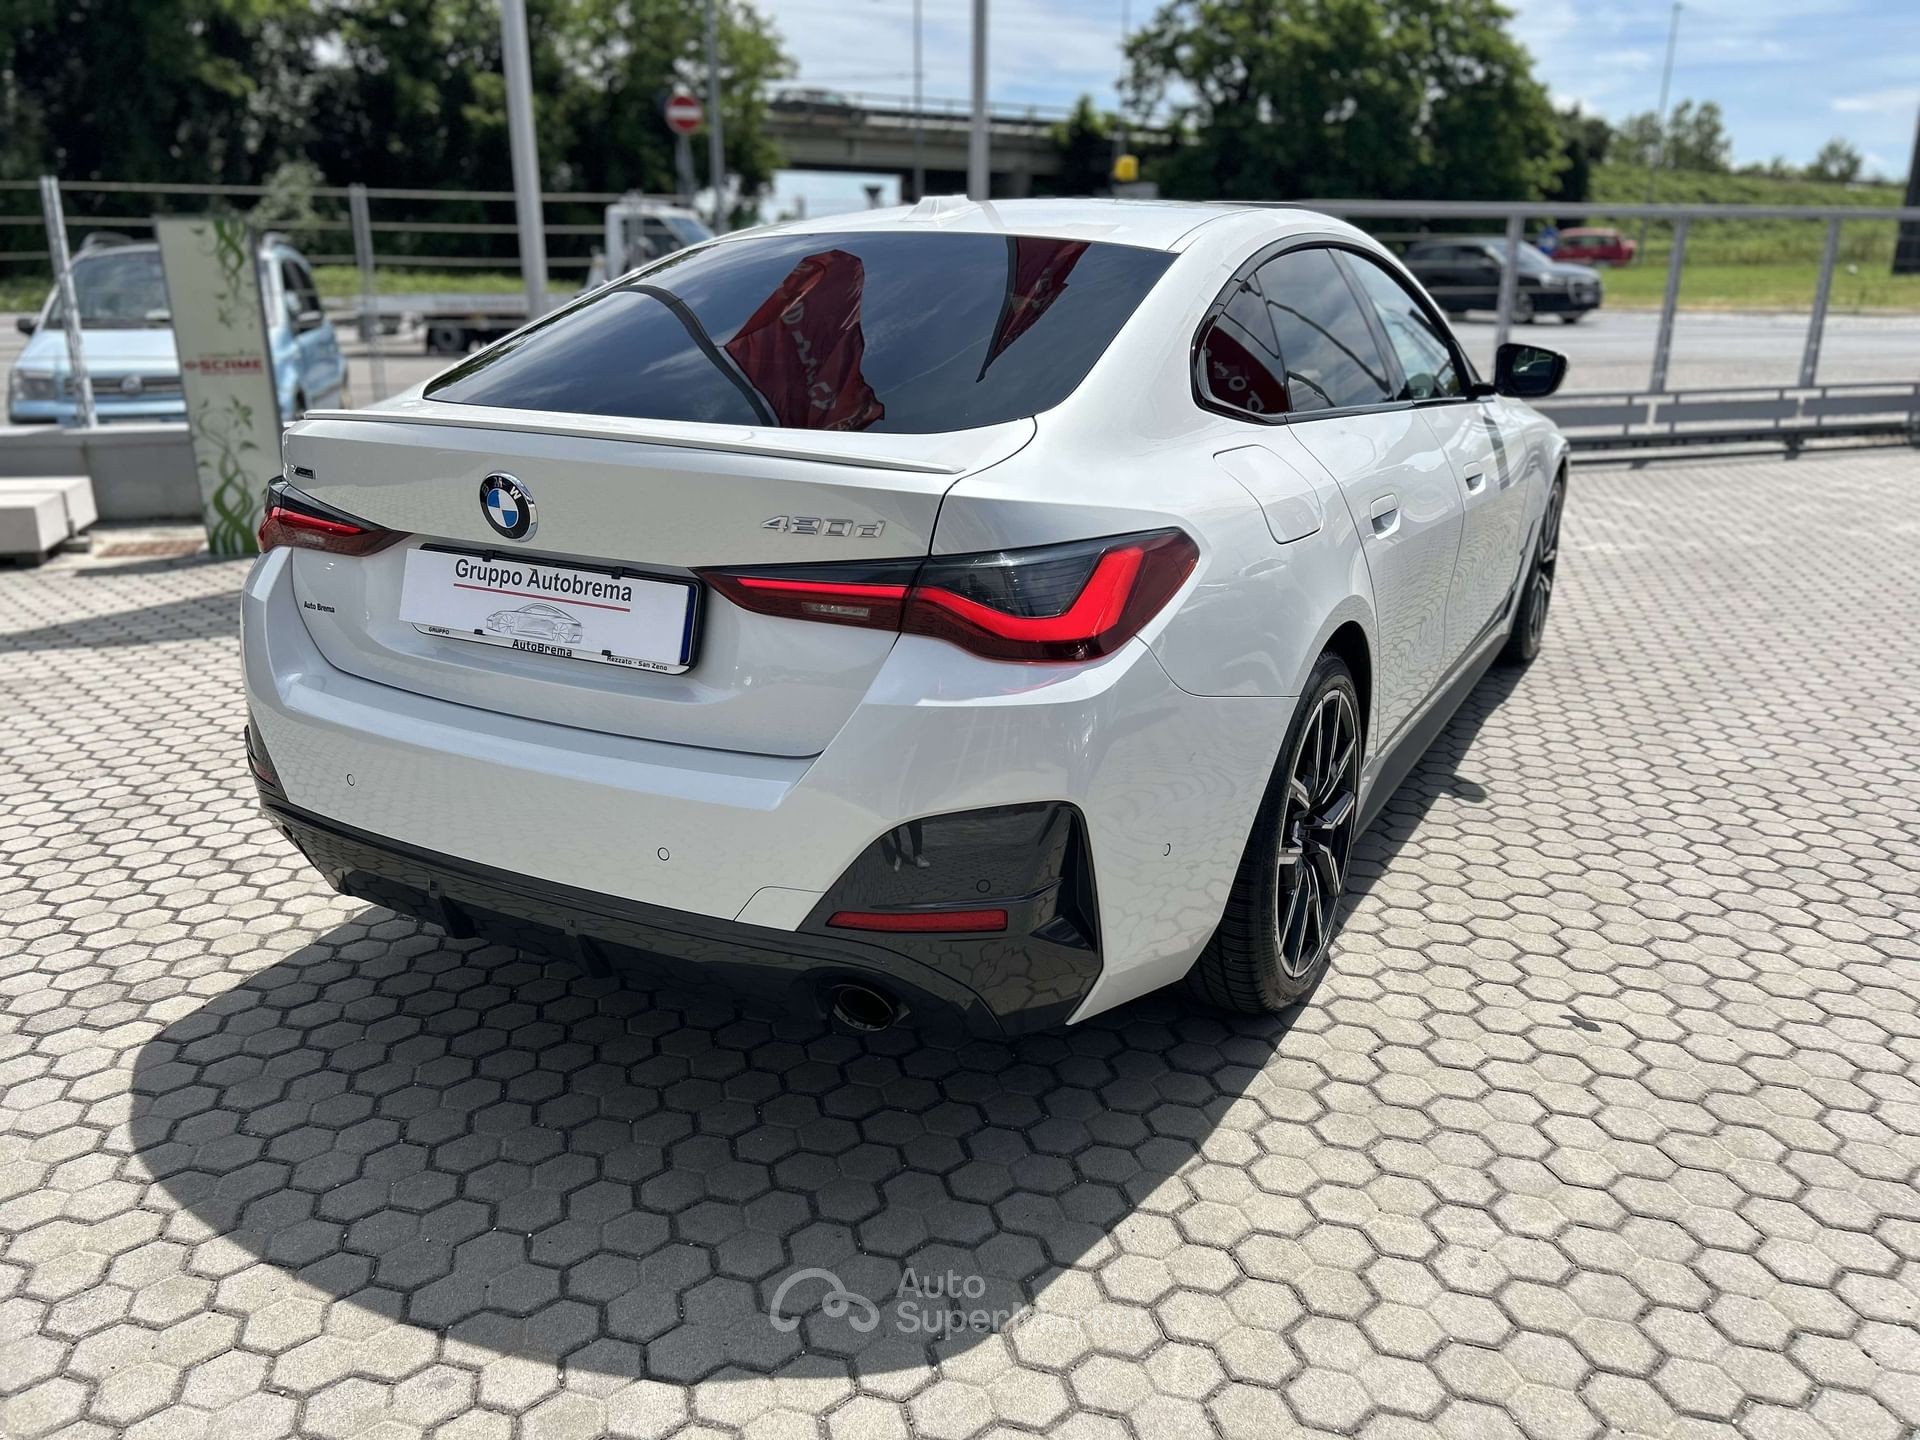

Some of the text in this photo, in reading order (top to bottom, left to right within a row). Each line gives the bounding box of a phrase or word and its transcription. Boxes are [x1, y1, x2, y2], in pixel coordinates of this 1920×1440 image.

[761, 516, 886, 538] 420d
[455, 559, 632, 602] Gruppo Autobrema
[428, 627, 450, 635] GRUPPO
[512, 639, 573, 657] AutoBrema
[651, 663, 668, 671] Zeno
